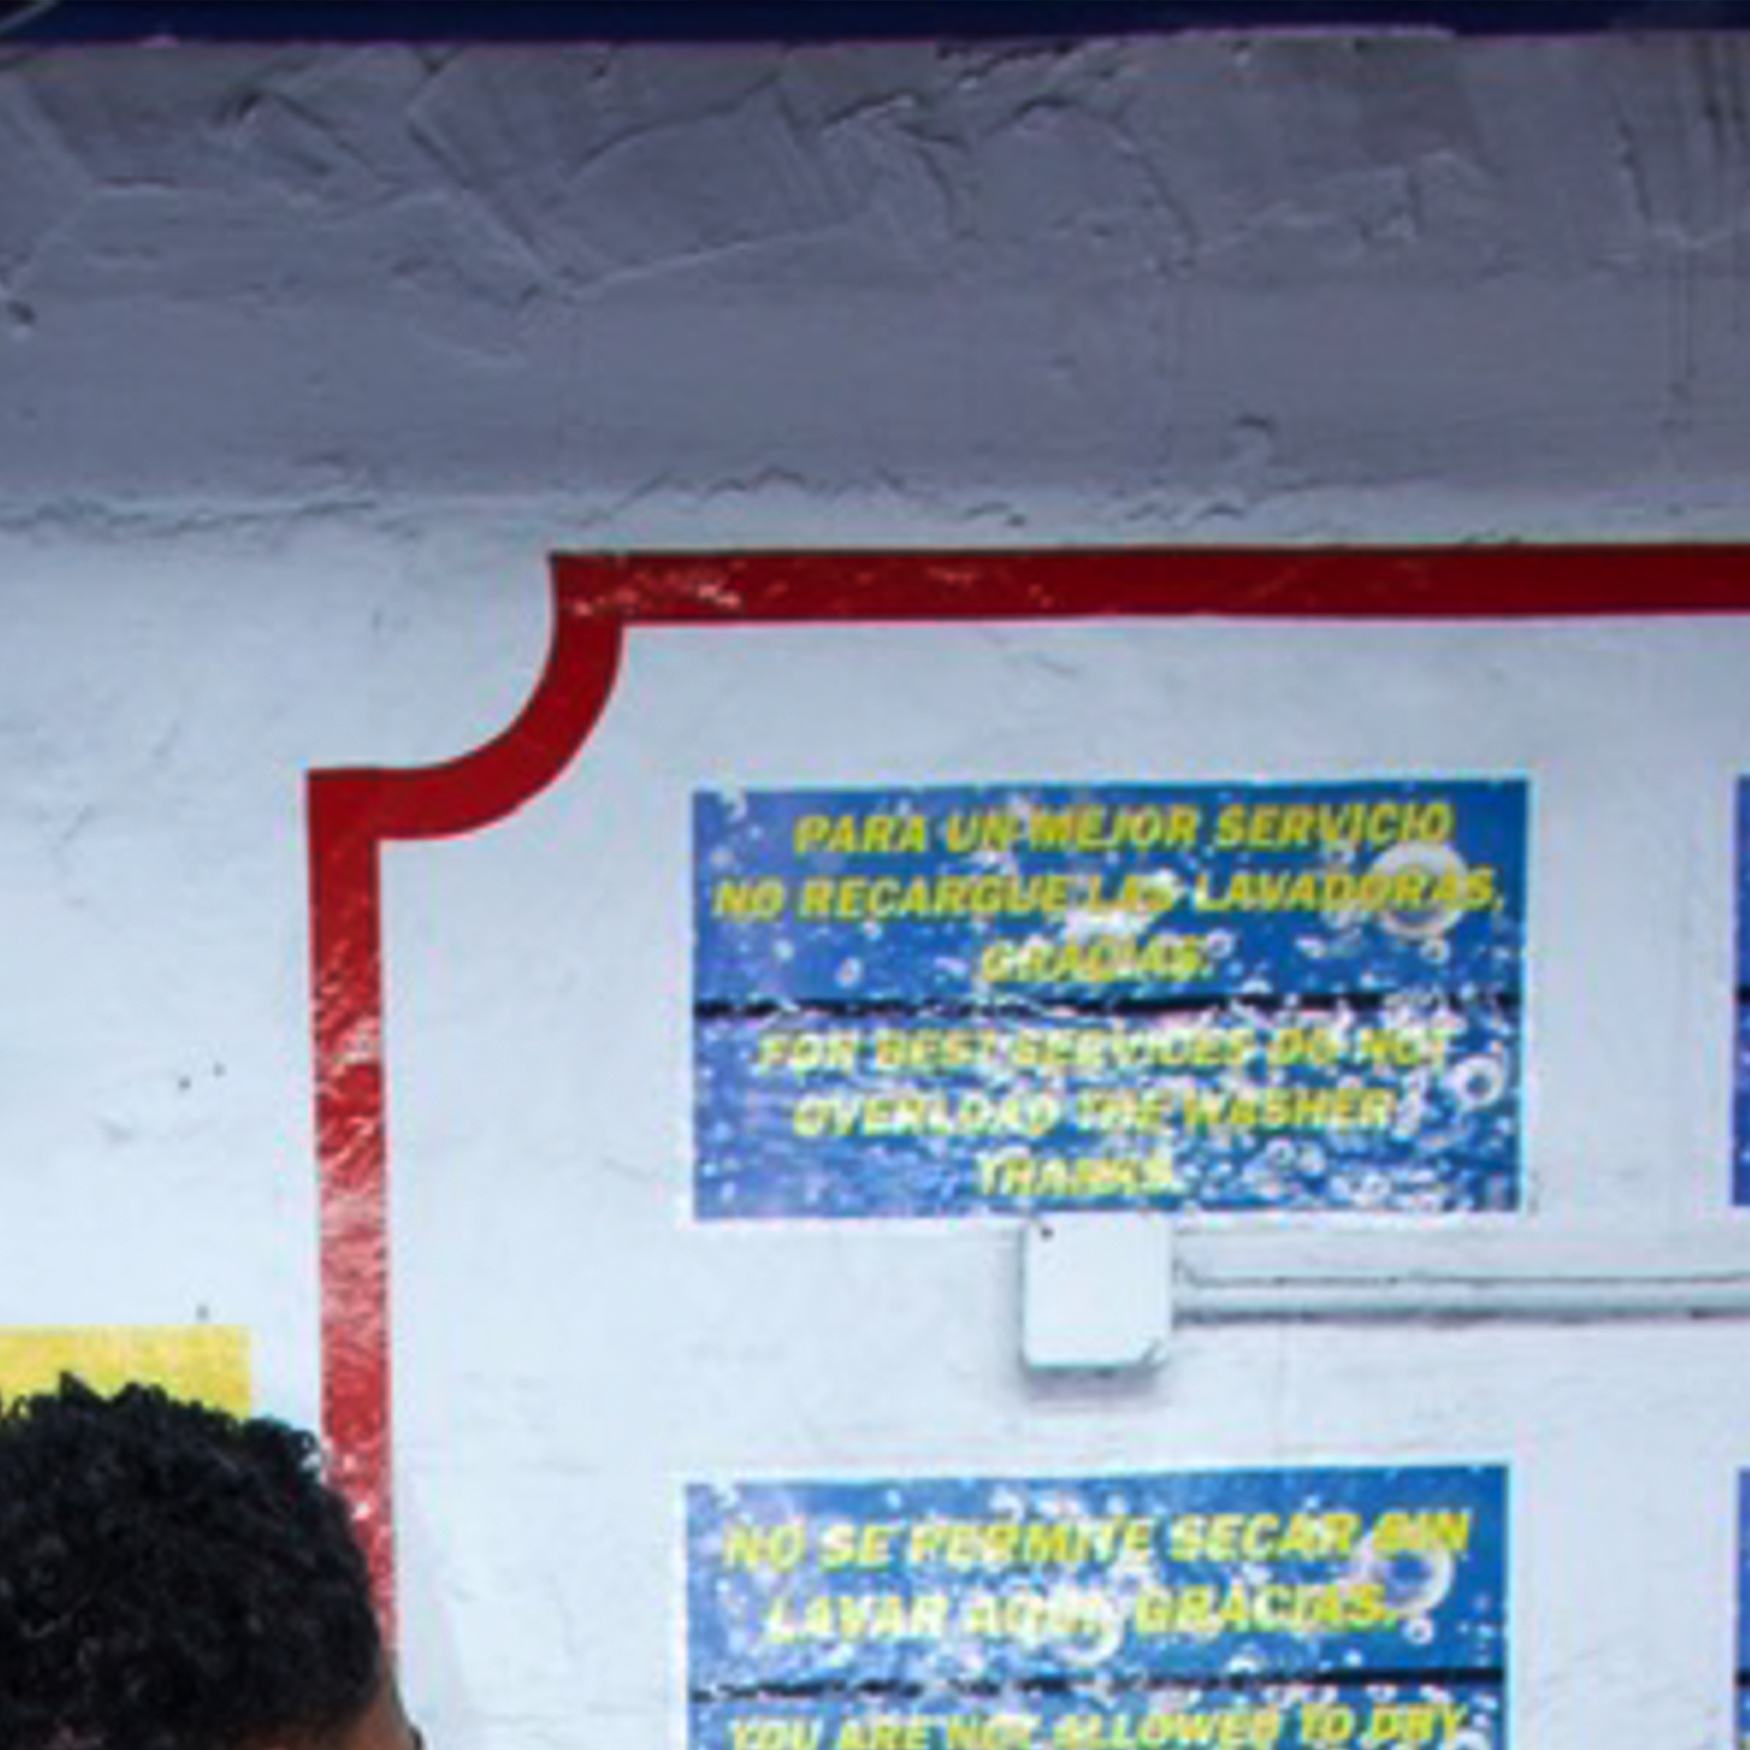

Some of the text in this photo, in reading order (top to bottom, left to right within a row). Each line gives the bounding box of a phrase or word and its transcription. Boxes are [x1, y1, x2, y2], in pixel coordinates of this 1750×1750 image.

[791, 800, 1456, 856] PARA UN MEJOR SERVICIO
[712, 876, 785, 921] NO
[795, 872, 1072, 920] RECARGUE
[722, 1522, 808, 1572] NO
[815, 1520, 895, 1572] SE
[904, 1516, 1155, 1570] PERMITE
[1168, 1511, 1362, 1562] SECAR
[765, 1591, 950, 1645] LAVAR
[1298, 1703, 1356, 1744] TO
[1365, 1700, 1468, 1744] DRY
